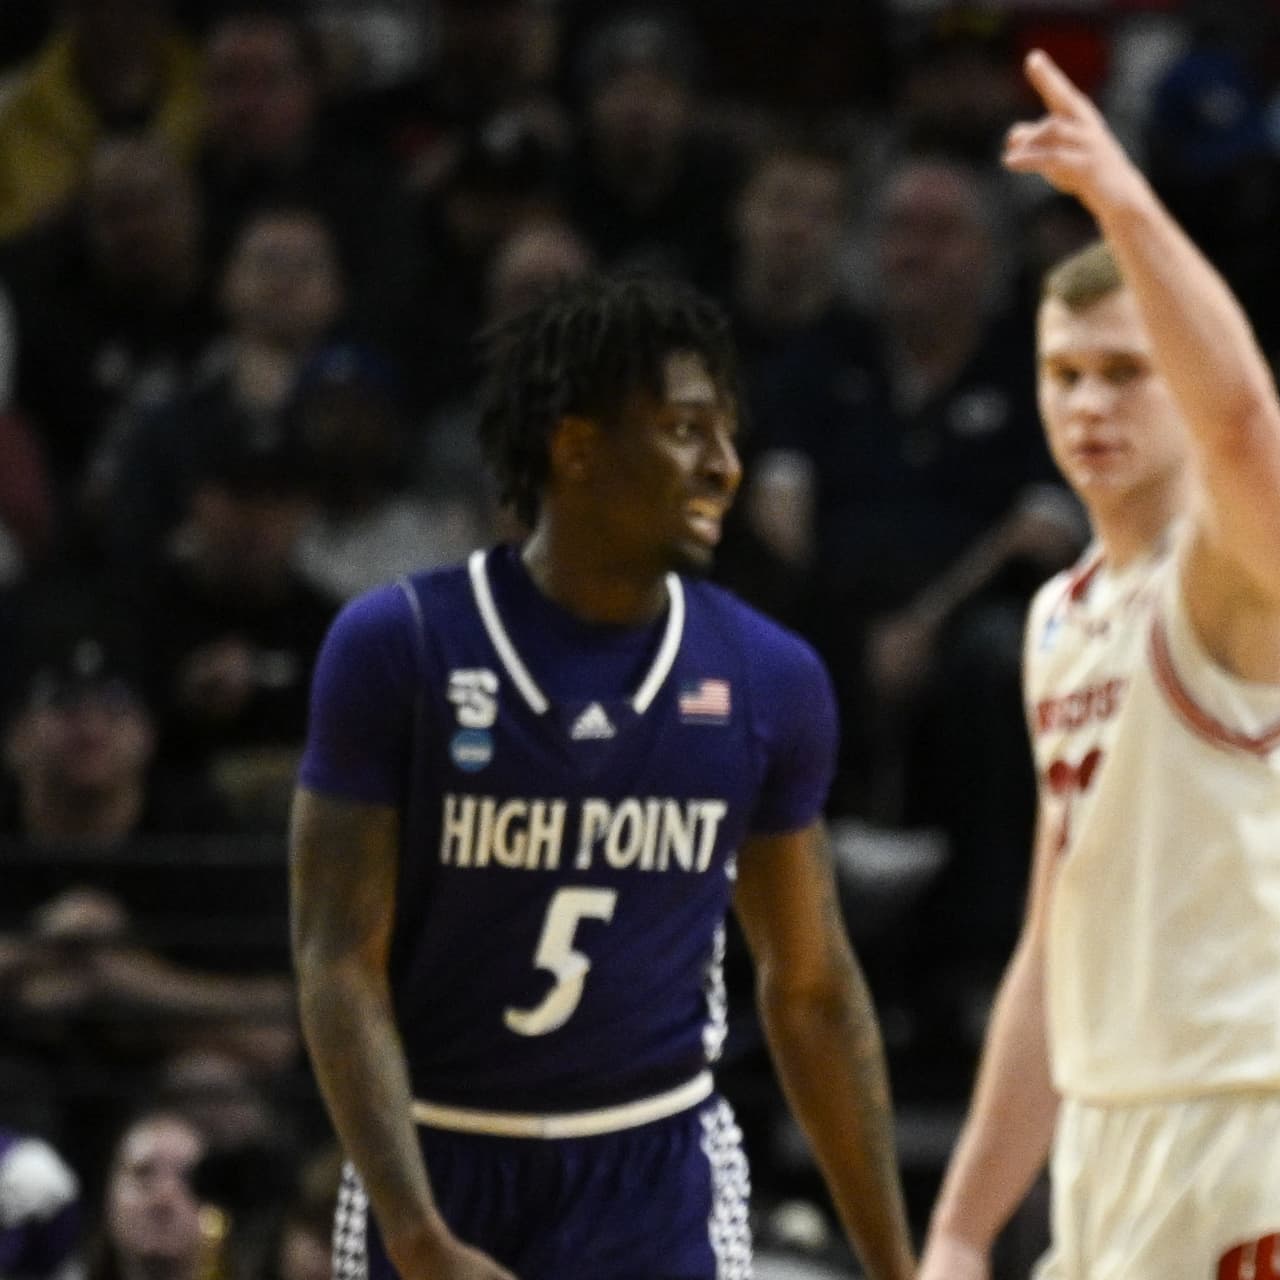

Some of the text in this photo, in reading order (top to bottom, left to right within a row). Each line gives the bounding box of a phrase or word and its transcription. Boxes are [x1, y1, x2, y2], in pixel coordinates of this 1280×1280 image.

[440, 797, 727, 872] HIGH POINT
[504, 888, 617, 1037] 5
